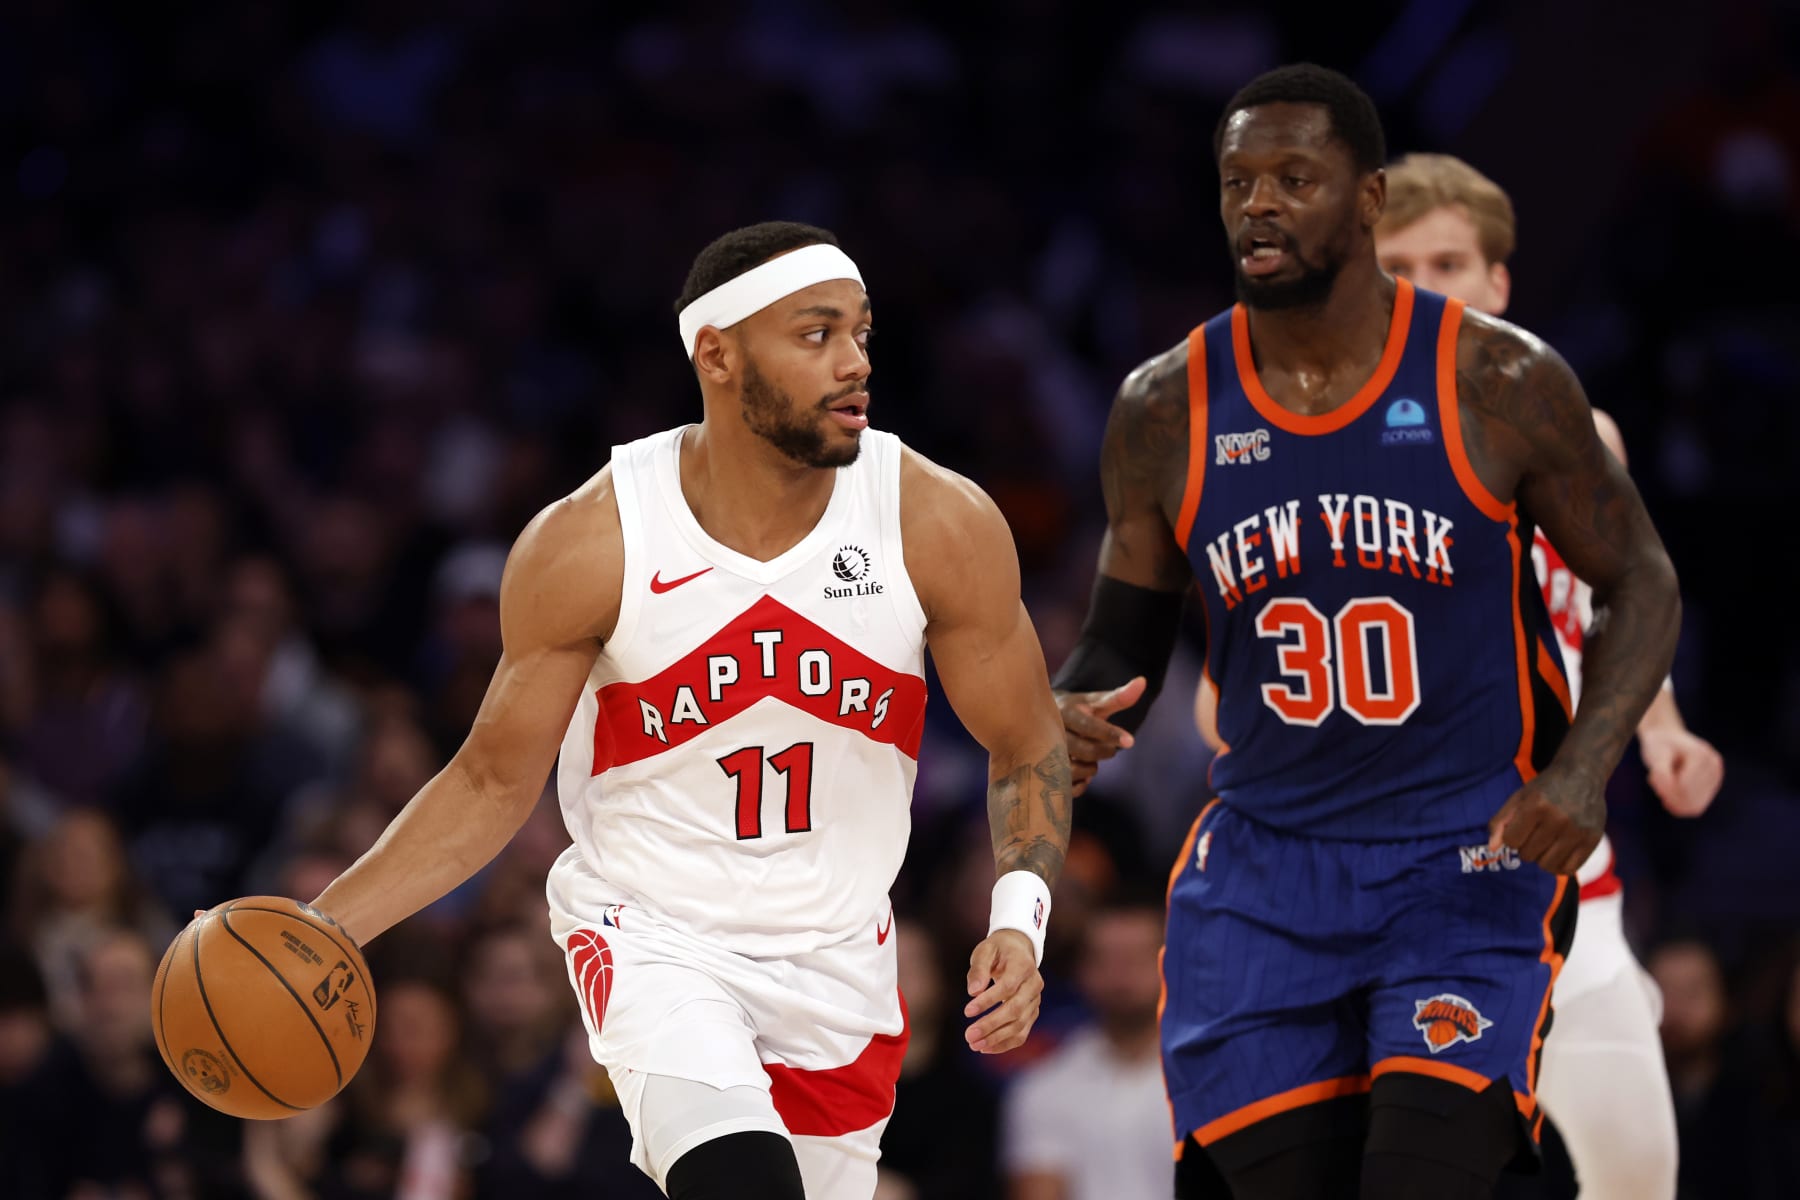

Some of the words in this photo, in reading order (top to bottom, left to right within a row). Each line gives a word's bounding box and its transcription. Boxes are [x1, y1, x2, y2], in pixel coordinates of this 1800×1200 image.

[1215, 429, 1271, 466] NYC
[824, 586, 853, 599] Sun
[856, 581, 884, 596] Life
[1206, 499, 1303, 611] NEW
[1318, 494, 1455, 587] YORK
[638, 630, 894, 745] RAPTORS
[1254, 596, 1422, 728] 30
[716, 742, 814, 841] 11
